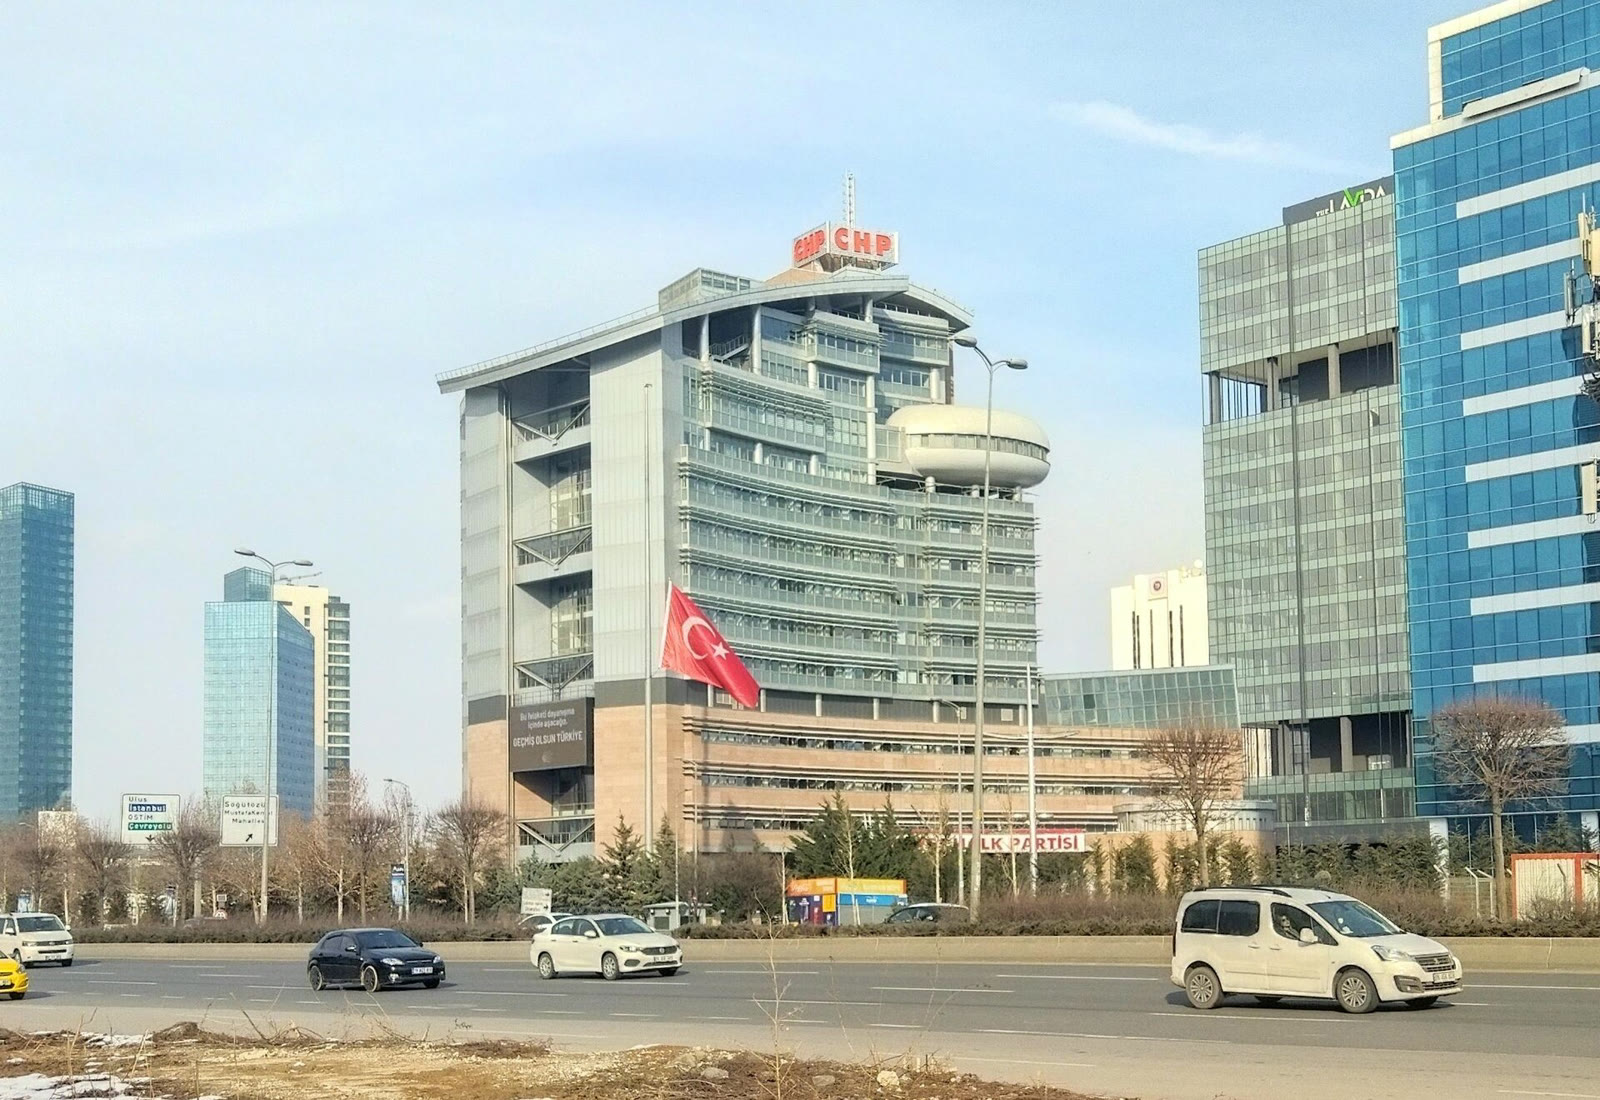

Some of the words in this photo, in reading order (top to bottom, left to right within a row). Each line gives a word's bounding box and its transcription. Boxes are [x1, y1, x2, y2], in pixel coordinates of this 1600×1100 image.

[794, 229, 825, 262] CHP
[834, 227, 892, 256] CHP
[513, 734, 535, 748] GEÇMİŞ
[535, 733, 556, 746] OLSUN
[556, 729, 583, 744] TÜRKİYE
